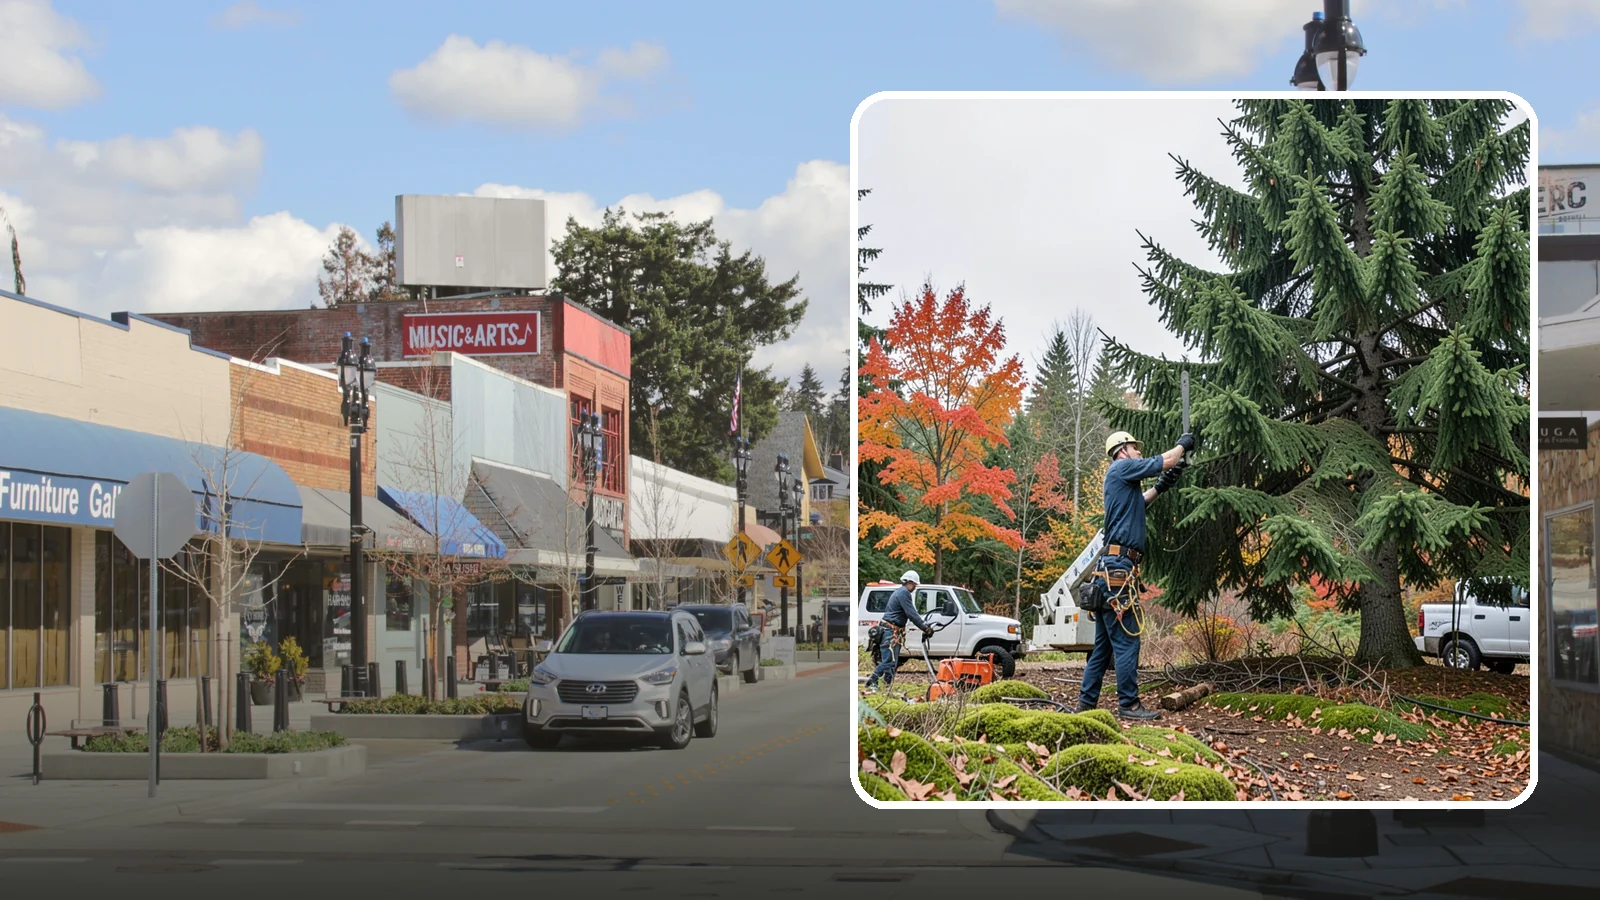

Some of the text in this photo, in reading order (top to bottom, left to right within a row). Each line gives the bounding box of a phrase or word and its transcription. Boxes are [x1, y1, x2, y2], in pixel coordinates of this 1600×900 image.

[408, 323, 520, 349] MUSIC&ARTS
[0, 471, 121, 519] Furniture Gal
